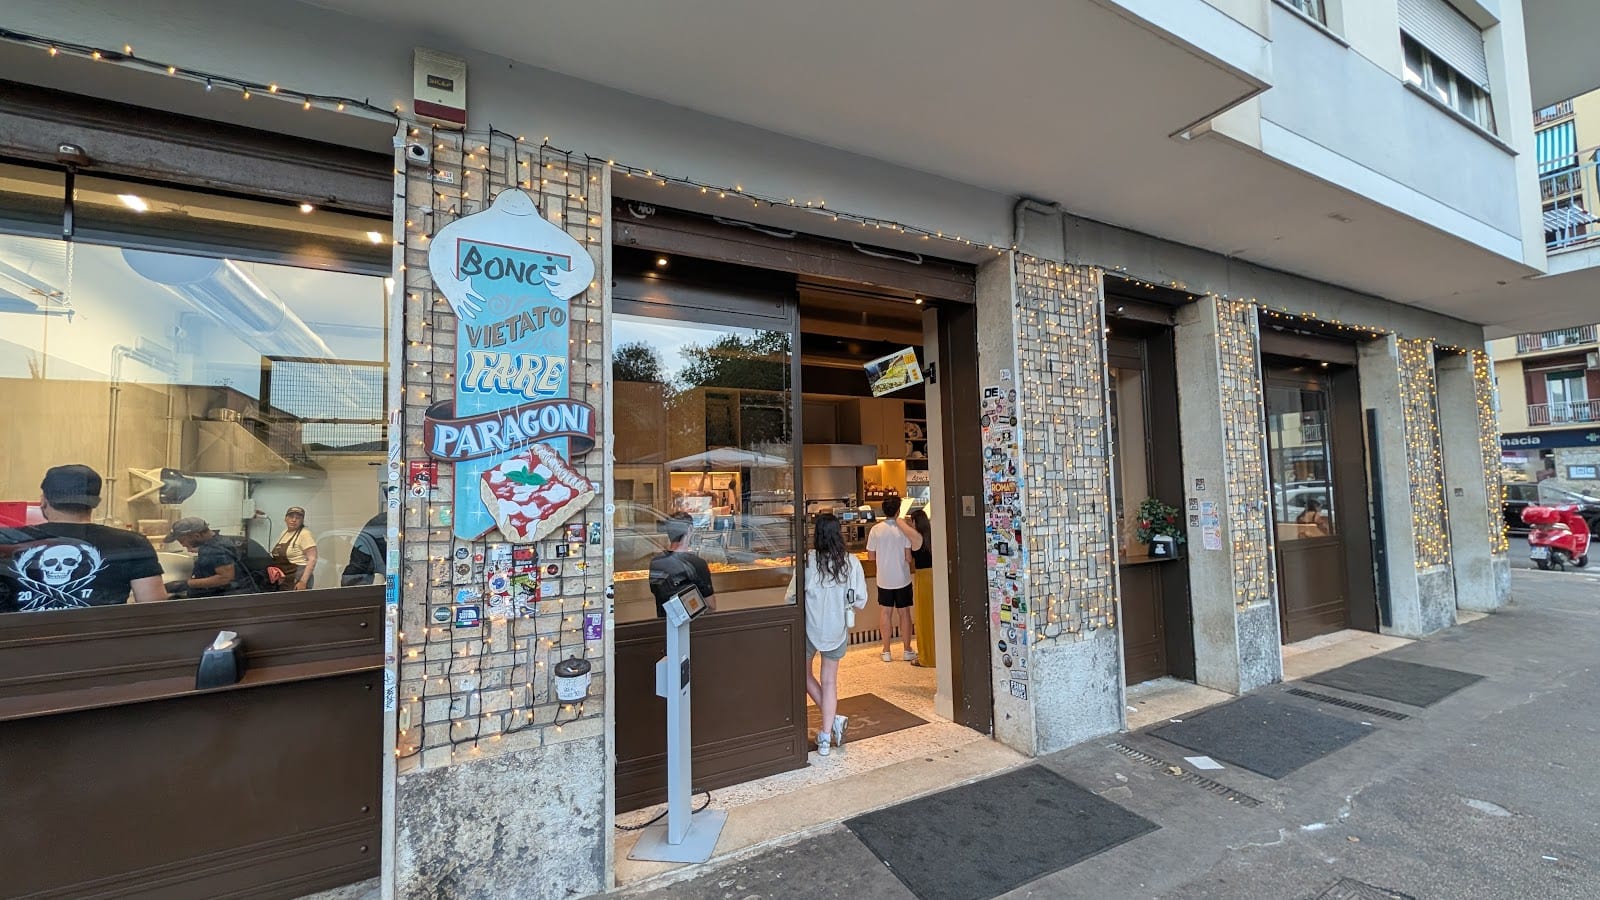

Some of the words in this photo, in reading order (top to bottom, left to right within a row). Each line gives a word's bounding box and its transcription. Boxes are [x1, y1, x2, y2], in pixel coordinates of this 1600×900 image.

[465, 306, 567, 348] VIETATO
[460, 350, 567, 400] FARE
[431, 402, 593, 458] PARAGONI
[1500, 435, 1541, 446] macia
[17, 591, 33, 602] 20
[81, 588, 94, 599] 17
